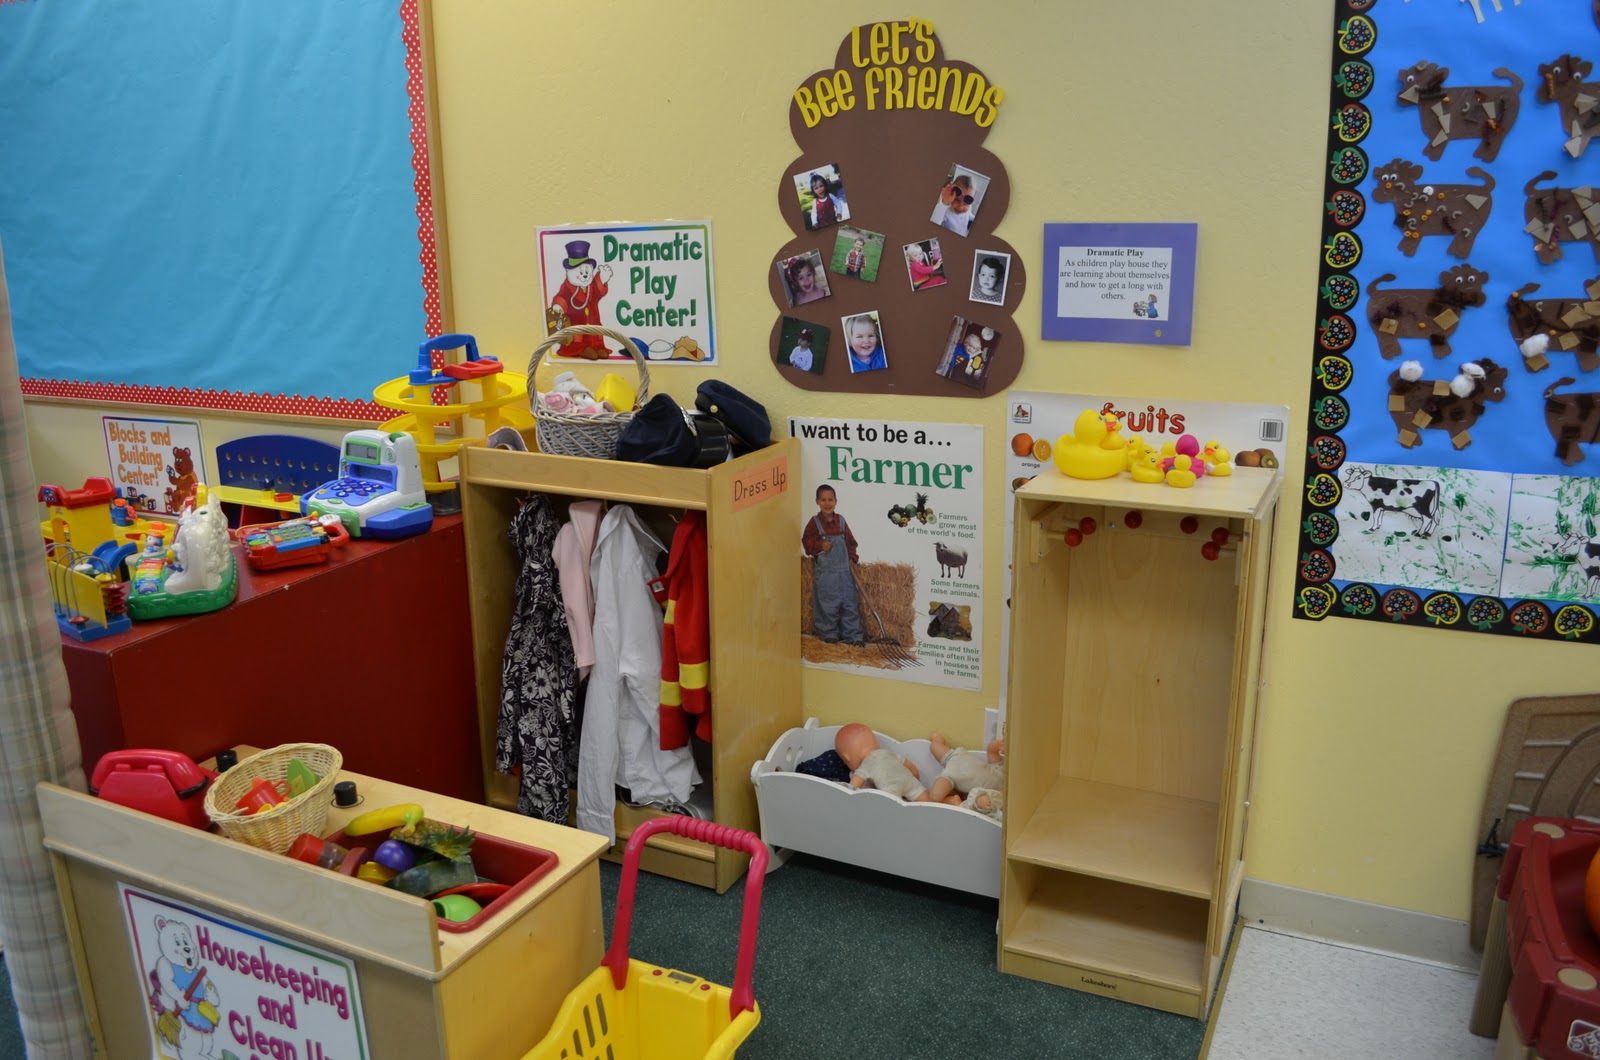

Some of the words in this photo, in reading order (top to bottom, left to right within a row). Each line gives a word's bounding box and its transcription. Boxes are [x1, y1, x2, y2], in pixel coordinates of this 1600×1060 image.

[851, 17, 935, 67] Let's
[793, 69, 856, 128] Bee
[603, 232, 703, 262] Dramatic
[1087, 248, 1124, 256] Dramatic
[1127, 249, 1144, 258] Play
[1074, 270, 1104, 279] learning
[1128, 271, 1169, 279] themselves
[1110, 260, 1126, 269] play
[1128, 260, 1150, 268] house
[1152, 261, 1168, 270] they
[630, 266, 677, 300] Play
[1128, 282, 1144, 291] long
[1147, 282, 1163, 290] with
[1101, 292, 1126, 300] others.
[616, 299, 696, 327] Center!
[108, 422, 147, 444] Blocks
[151, 426, 171, 446] and
[790, 420, 795, 437] I
[801, 423, 850, 440] want
[856, 424, 878, 442] to
[884, 425, 908, 443] be
[118, 444, 163, 472] Building
[826, 446, 973, 490] Farmer
[118, 464, 160, 486] Center!
[735, 480, 767, 501] Dress
[773, 466, 786, 492] Up
[939, 513, 968, 521] Farmers
[930, 528, 955, 537] world's
[958, 531, 976, 539] food.
[930, 587, 948, 595] raise
[950, 589, 980, 598] animals.
[931, 579, 950, 587] Some
[953, 581, 980, 590] farmers
[917, 649, 944, 658] families
[947, 653, 965, 661] often
[918, 641, 946, 650] Farmers
[963, 647, 979, 655] their
[944, 660, 968, 669] houses
[944, 668, 955, 676] the
[957, 670, 979, 679] farms.
[195, 924, 350, 1020] Housekeeping
[258, 995, 298, 1030] and
[228, 1010, 298, 1060] Clean
[306, 1039, 334, 1060] U
